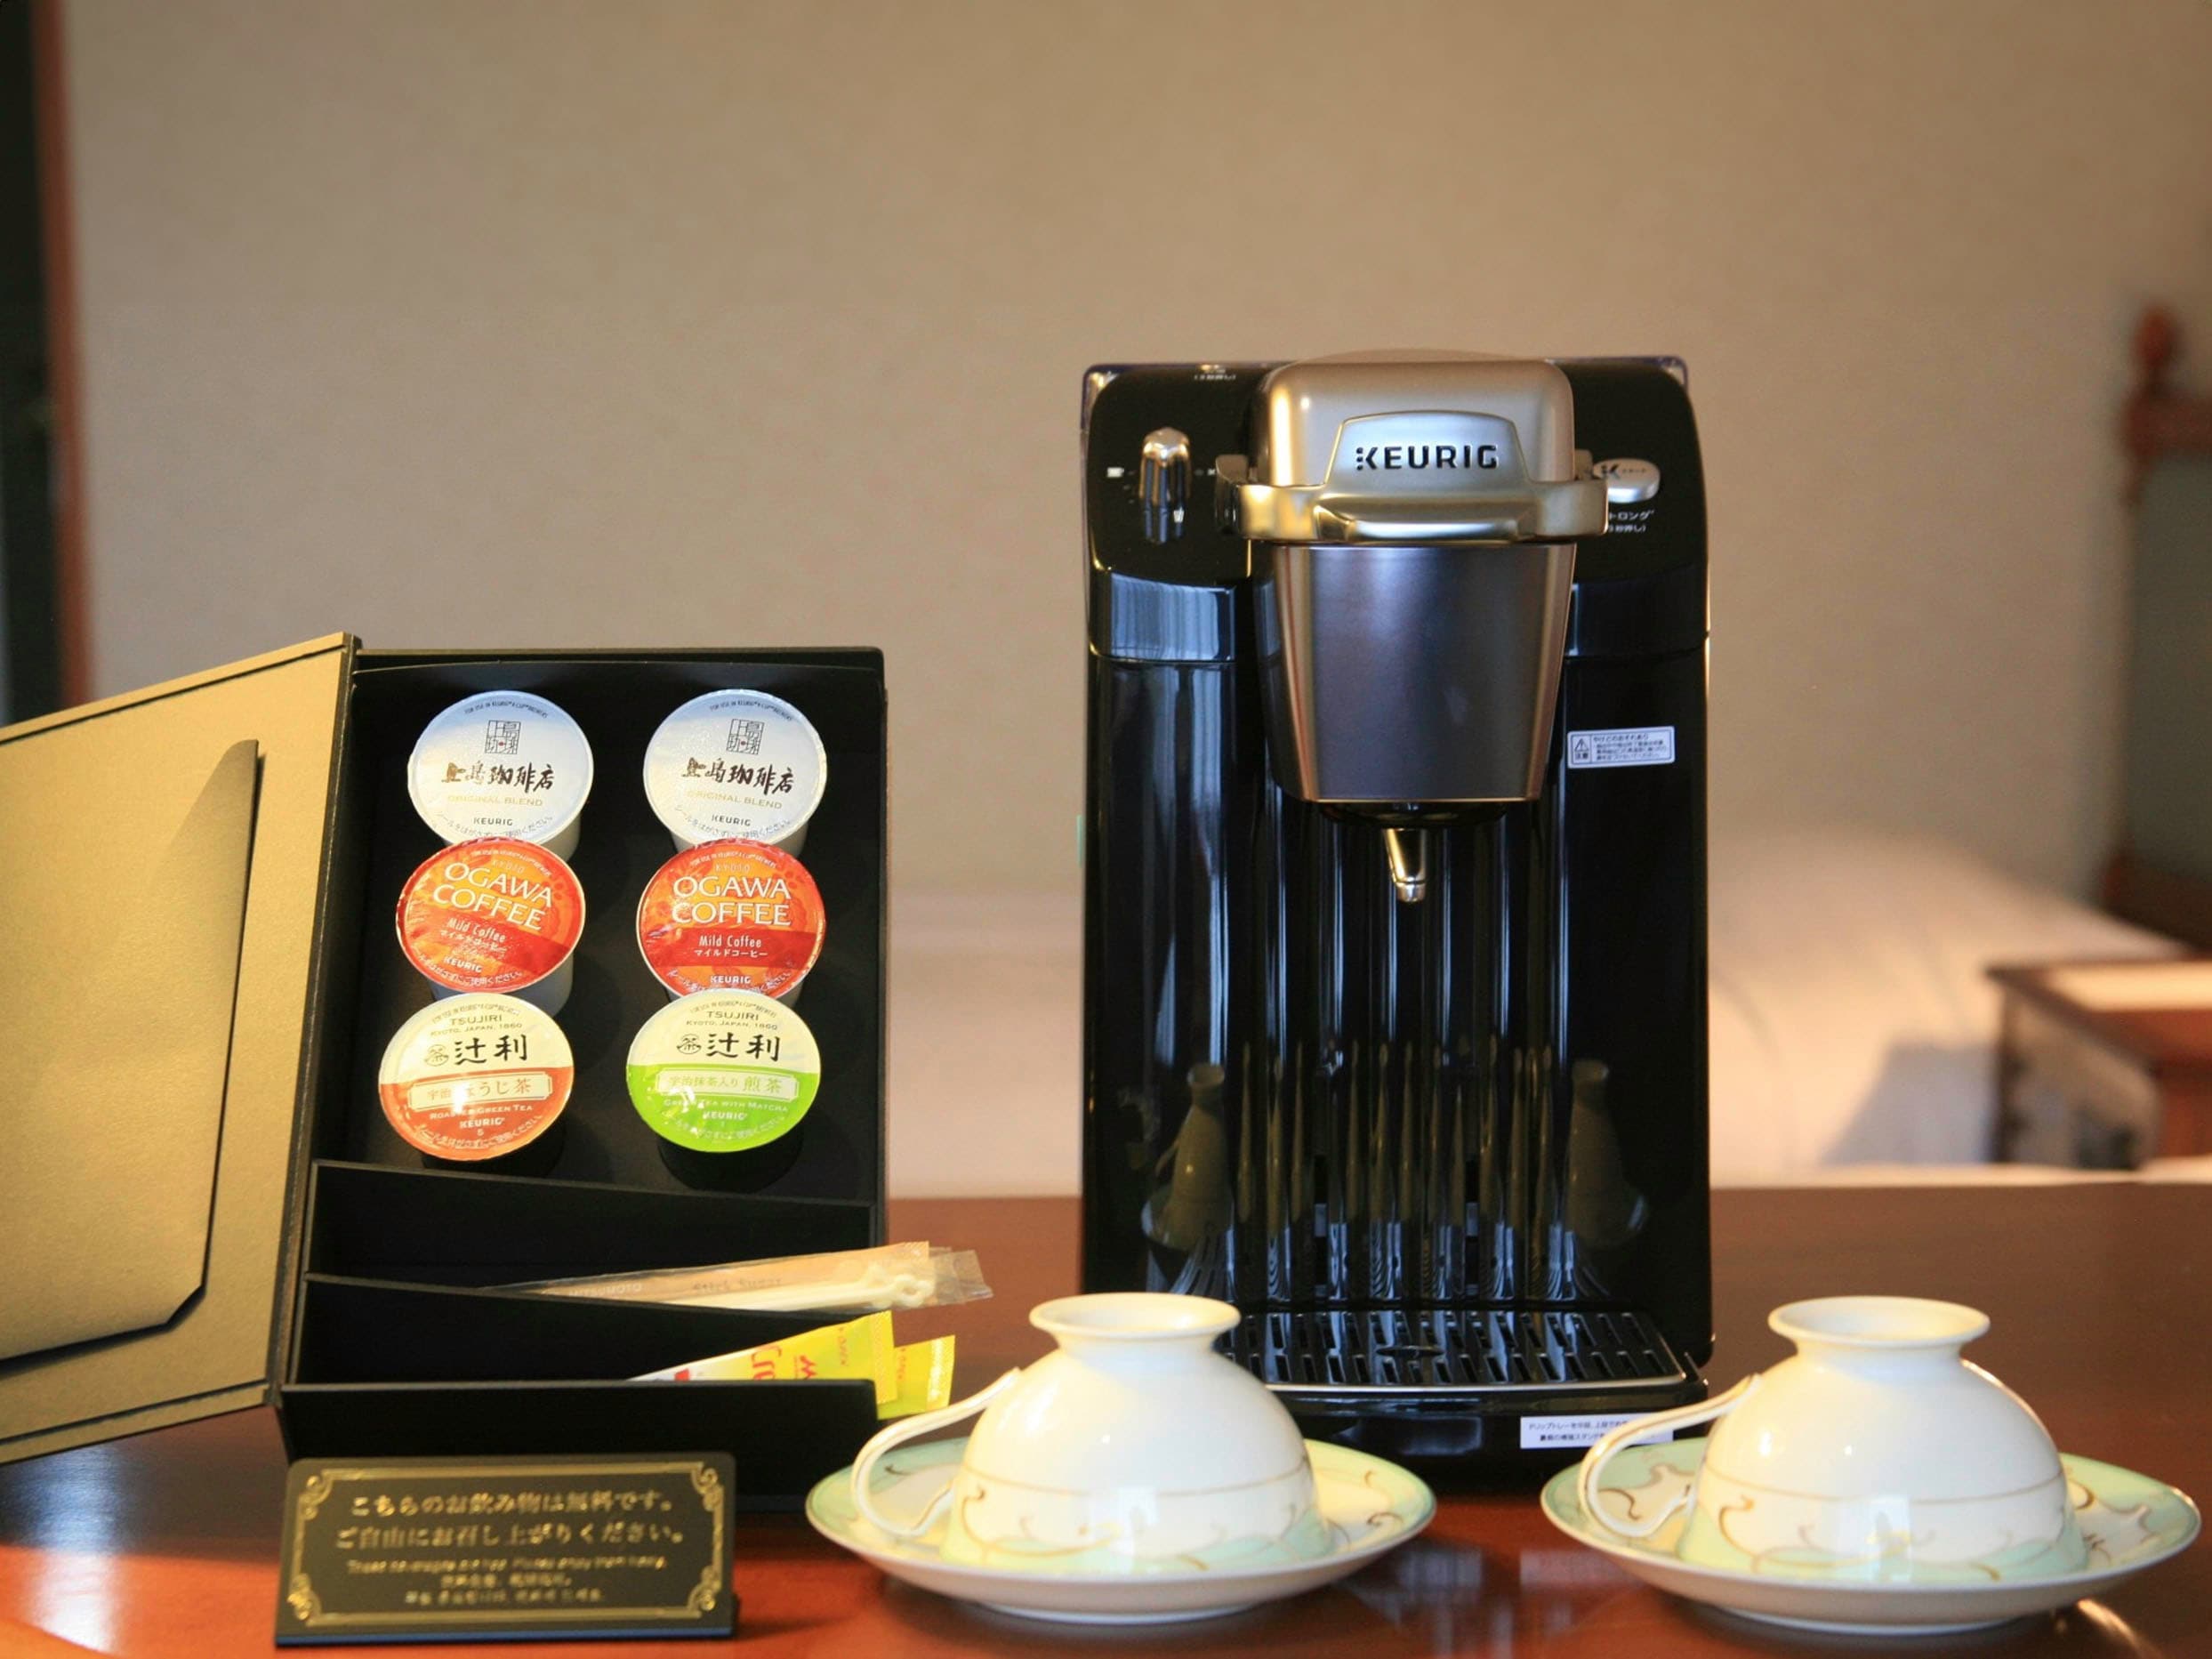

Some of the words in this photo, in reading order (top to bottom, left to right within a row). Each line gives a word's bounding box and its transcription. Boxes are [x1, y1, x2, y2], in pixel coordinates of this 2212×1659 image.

[1356, 445, 1498, 471] KEURIG
[504, 797, 543, 808] BLEND
[744, 797, 783, 809] BLEND
[473, 817, 513, 826] KEURIG
[712, 814, 752, 826] KEURIG
[444, 862, 552, 908] OGAWA
[672, 875, 792, 900] OGAWA
[432, 884, 546, 930] COFFEE
[672, 901, 792, 927] COFFEE
[446, 917, 471, 932] Mild
[472, 923, 506, 943] Coffee
[699, 935, 722, 947] Mild
[727, 935, 762, 948] Coffee
[694, 948, 768, 959] マイルドコーヒー
[444, 954, 483, 973] KEURIG
[711, 975, 752, 985] KEURIG
[451, 1014, 503, 1026] TSUJIRI
[706, 1011, 759, 1020] TSUJIRI
[454, 1034, 527, 1066] 辻利
[706, 1032, 782, 1061] 辻利
[478, 1105, 512, 1115] GREEN
[513, 1104, 534, 1112] TEA
[748, 1101, 789, 1113] MATCHA
[703, 1111, 748, 1121] KEURIG
[460, 1117, 503, 1129] KEURIG
